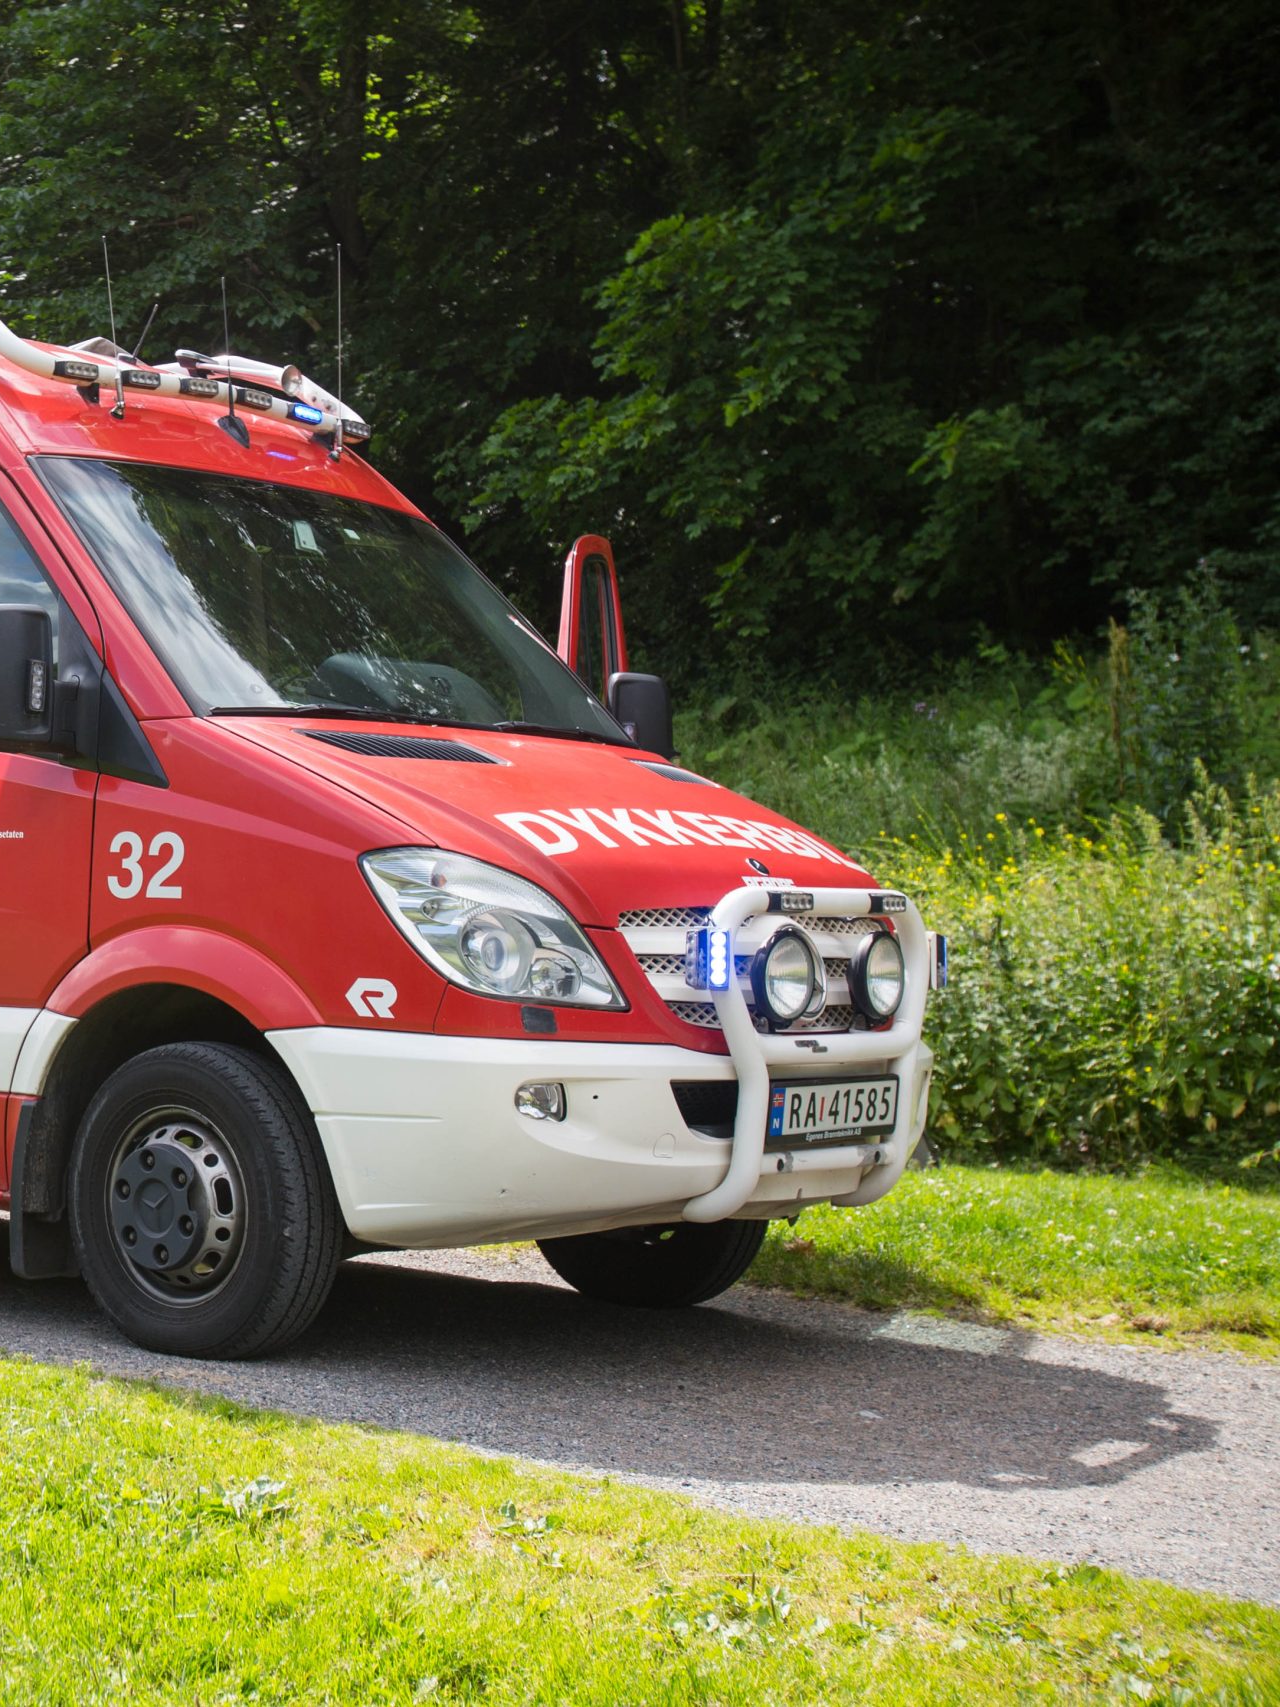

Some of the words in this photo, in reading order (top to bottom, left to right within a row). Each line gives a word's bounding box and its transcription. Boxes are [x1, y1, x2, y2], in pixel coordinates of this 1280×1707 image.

[107, 830, 185, 900] 32
[494, 808, 871, 875] DYKKERBIL
[772, 1118, 780, 1128] N
[828, 1086, 891, 1125] 41585
